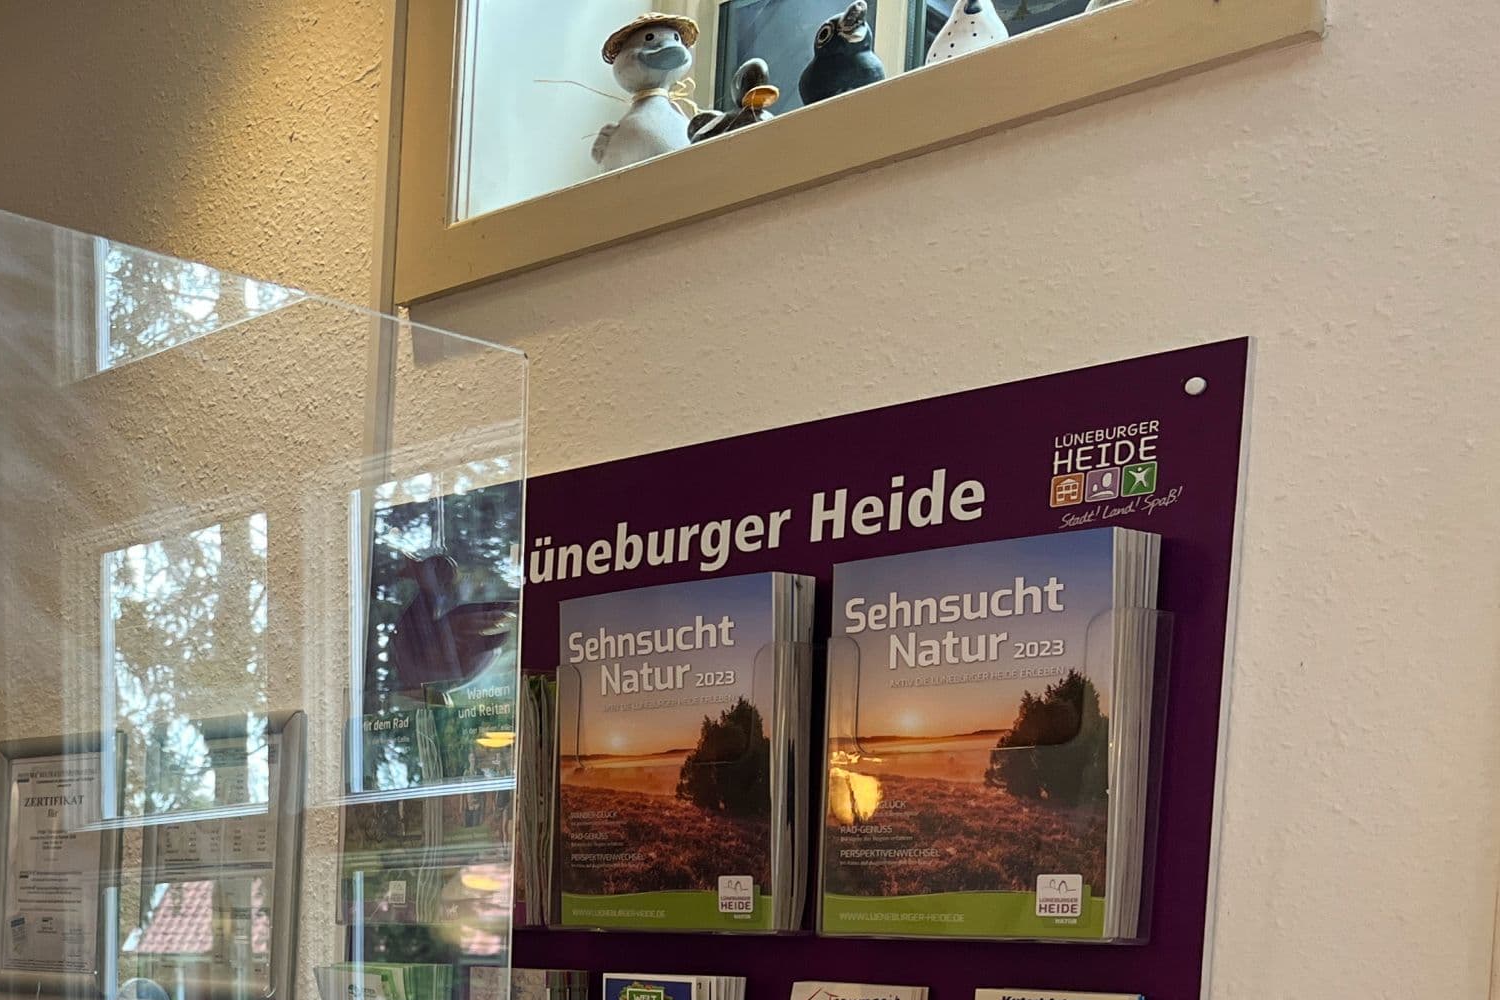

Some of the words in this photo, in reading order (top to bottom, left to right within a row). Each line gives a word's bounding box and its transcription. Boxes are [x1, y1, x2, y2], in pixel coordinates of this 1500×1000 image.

[1055, 420, 1159, 448] LÜNEBURGER
[1053, 435, 1158, 475] HEIDE
[809, 468, 986, 544] Heide
[845, 576, 1064, 634] Sehnsucht
[568, 615, 735, 663] Sehnsucht
[889, 631, 1008, 670] Natur
[1013, 639, 1065, 659] 2023
[600, 662, 691, 696] Natur
[695, 670, 735, 688] 2023
[1020, 666, 1065, 679] ERLEBEN
[393, 716, 409, 728] Rad
[24, 795, 84, 807] ZERTIFIKAT
[840, 848, 941, 858] PERSPEKTIVENWECHSEL
[720, 901, 752, 911] HEIDE
[1038, 903, 1078, 914] HEIDE
